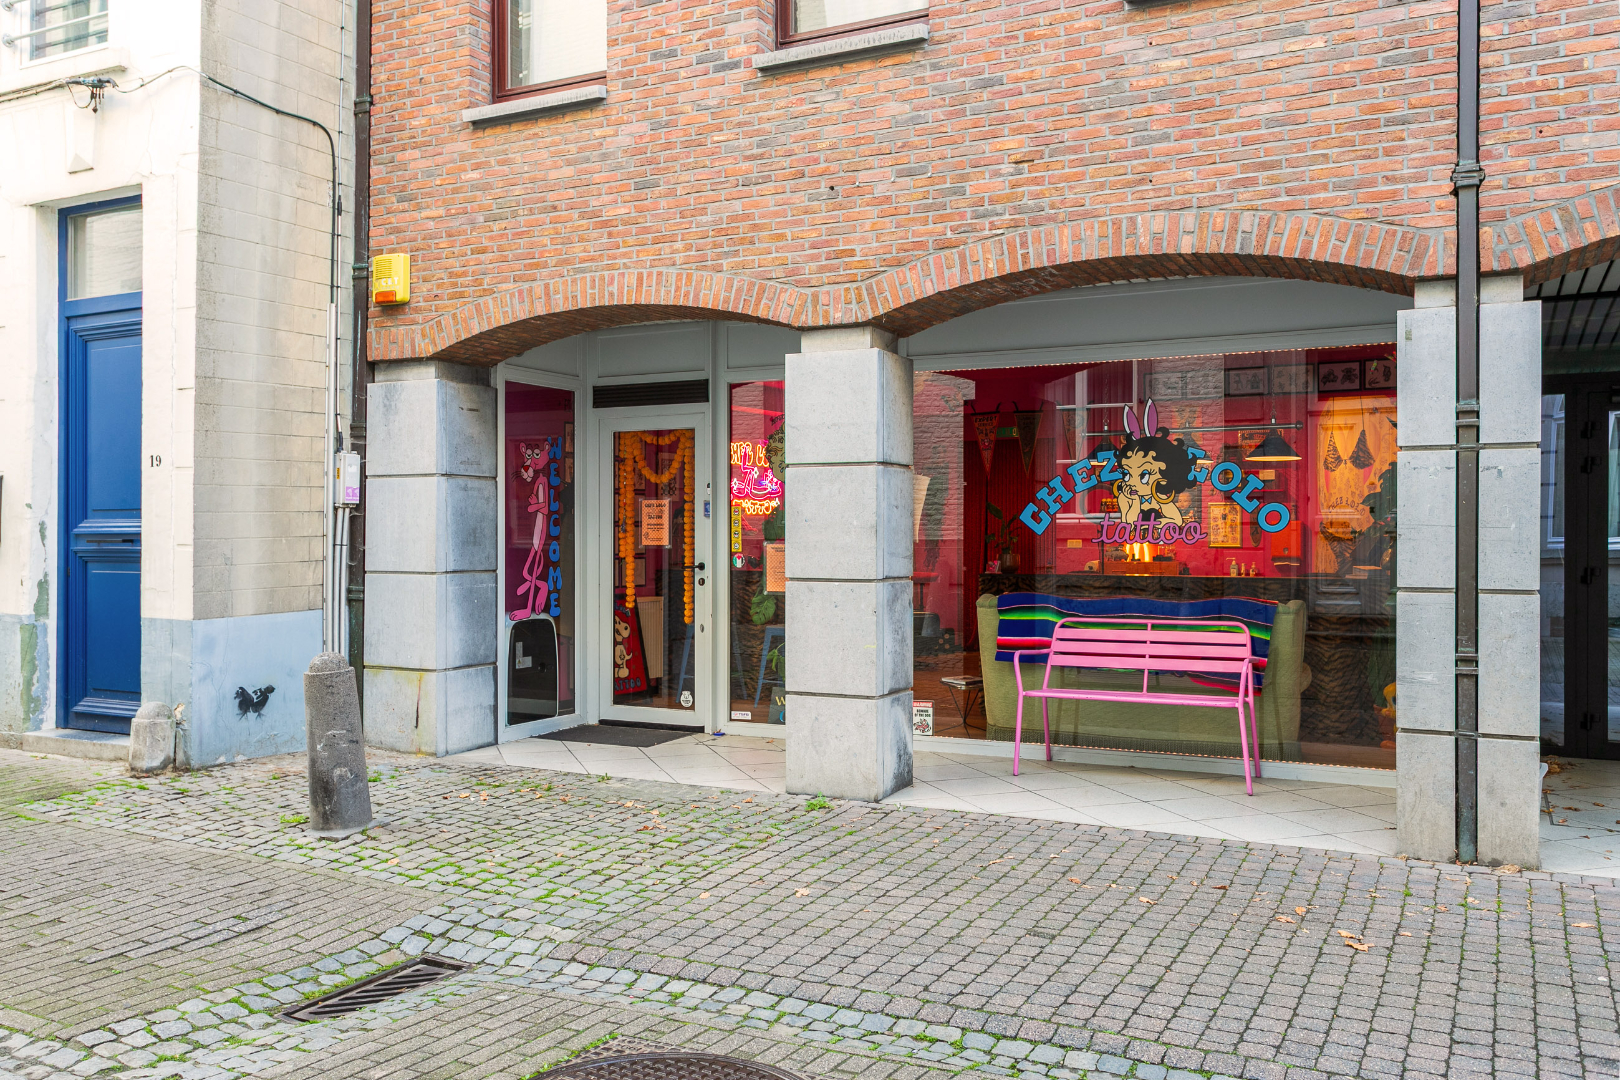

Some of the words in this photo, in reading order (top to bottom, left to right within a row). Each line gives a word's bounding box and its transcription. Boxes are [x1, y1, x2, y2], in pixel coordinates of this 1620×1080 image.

[149, 454, 162, 468] 19
[1019, 450, 1124, 536] CHEZ
[548, 436, 562, 617] WELCOME
[1091, 512, 1208, 546] tattoo
[614, 677, 642, 692] ATTOO
